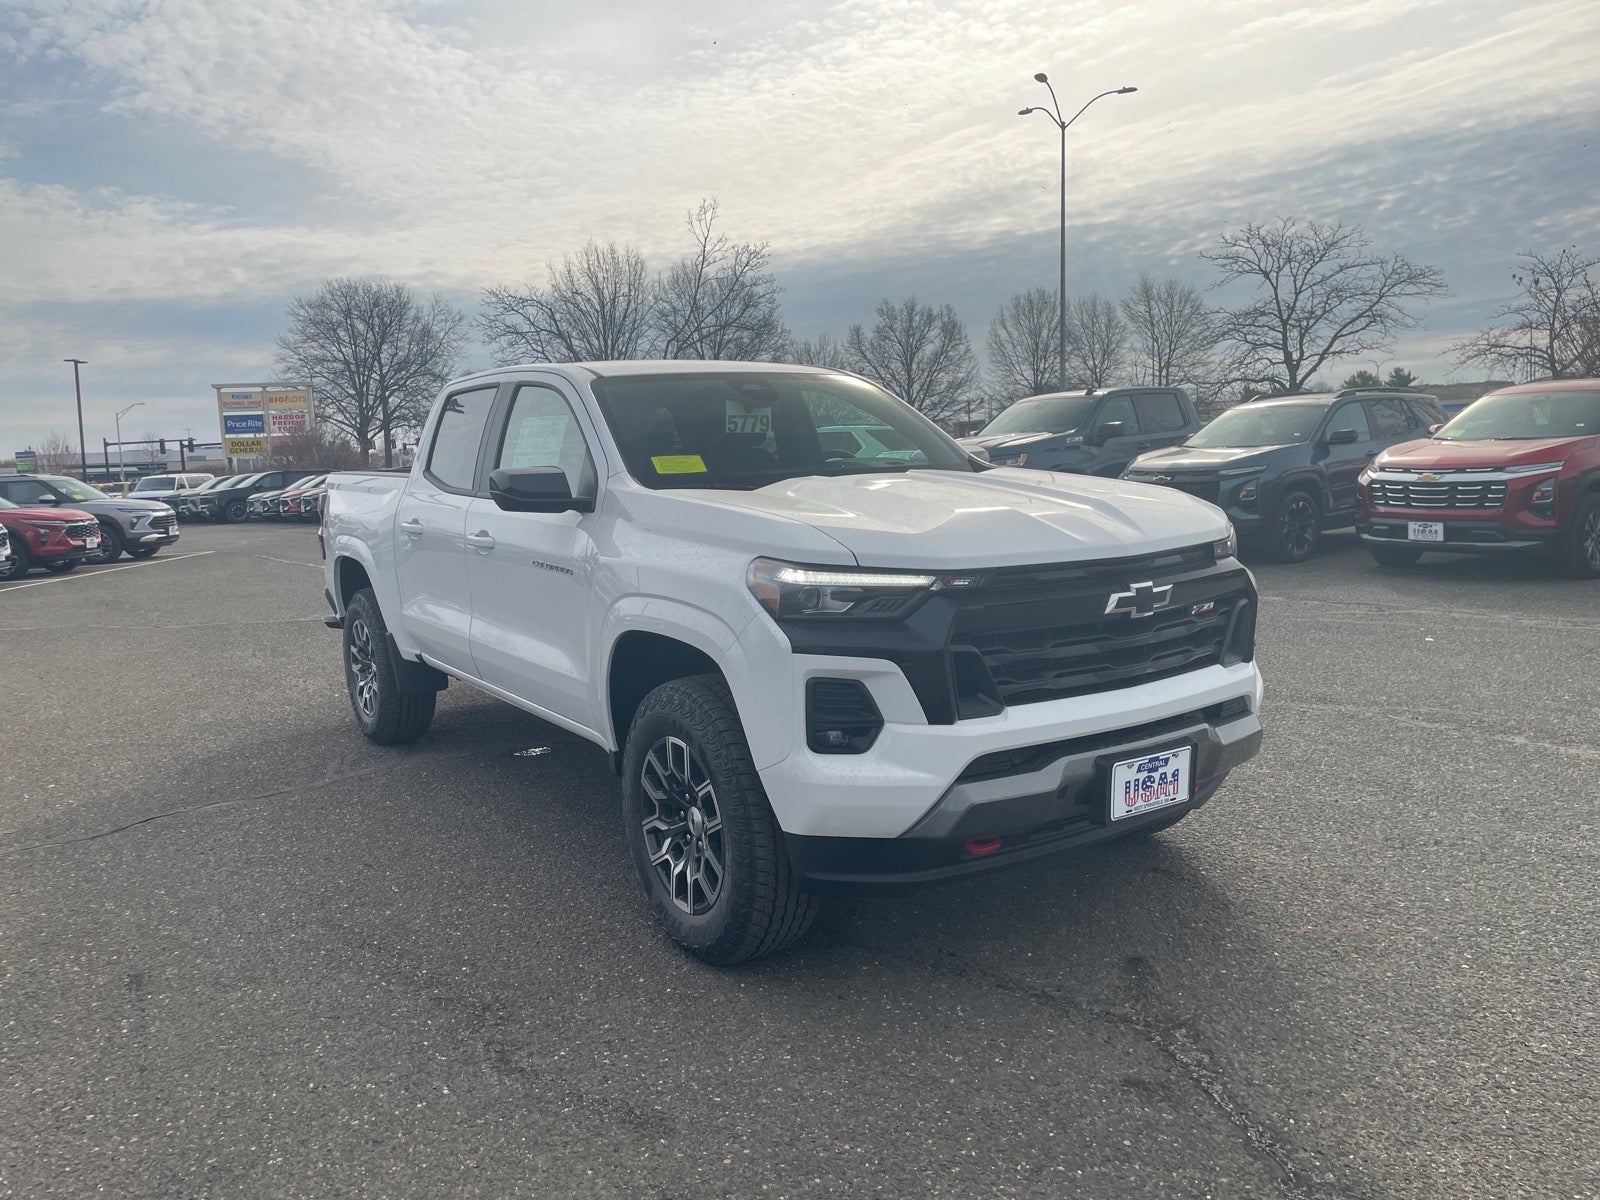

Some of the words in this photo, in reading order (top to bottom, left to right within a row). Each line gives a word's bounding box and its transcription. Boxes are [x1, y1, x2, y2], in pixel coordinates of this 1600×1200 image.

[227, 420, 247, 428] Price
[248, 419, 263, 427] Rite
[728, 414, 770, 432] 5779
[1140, 760, 1166, 770] CENTRAL
